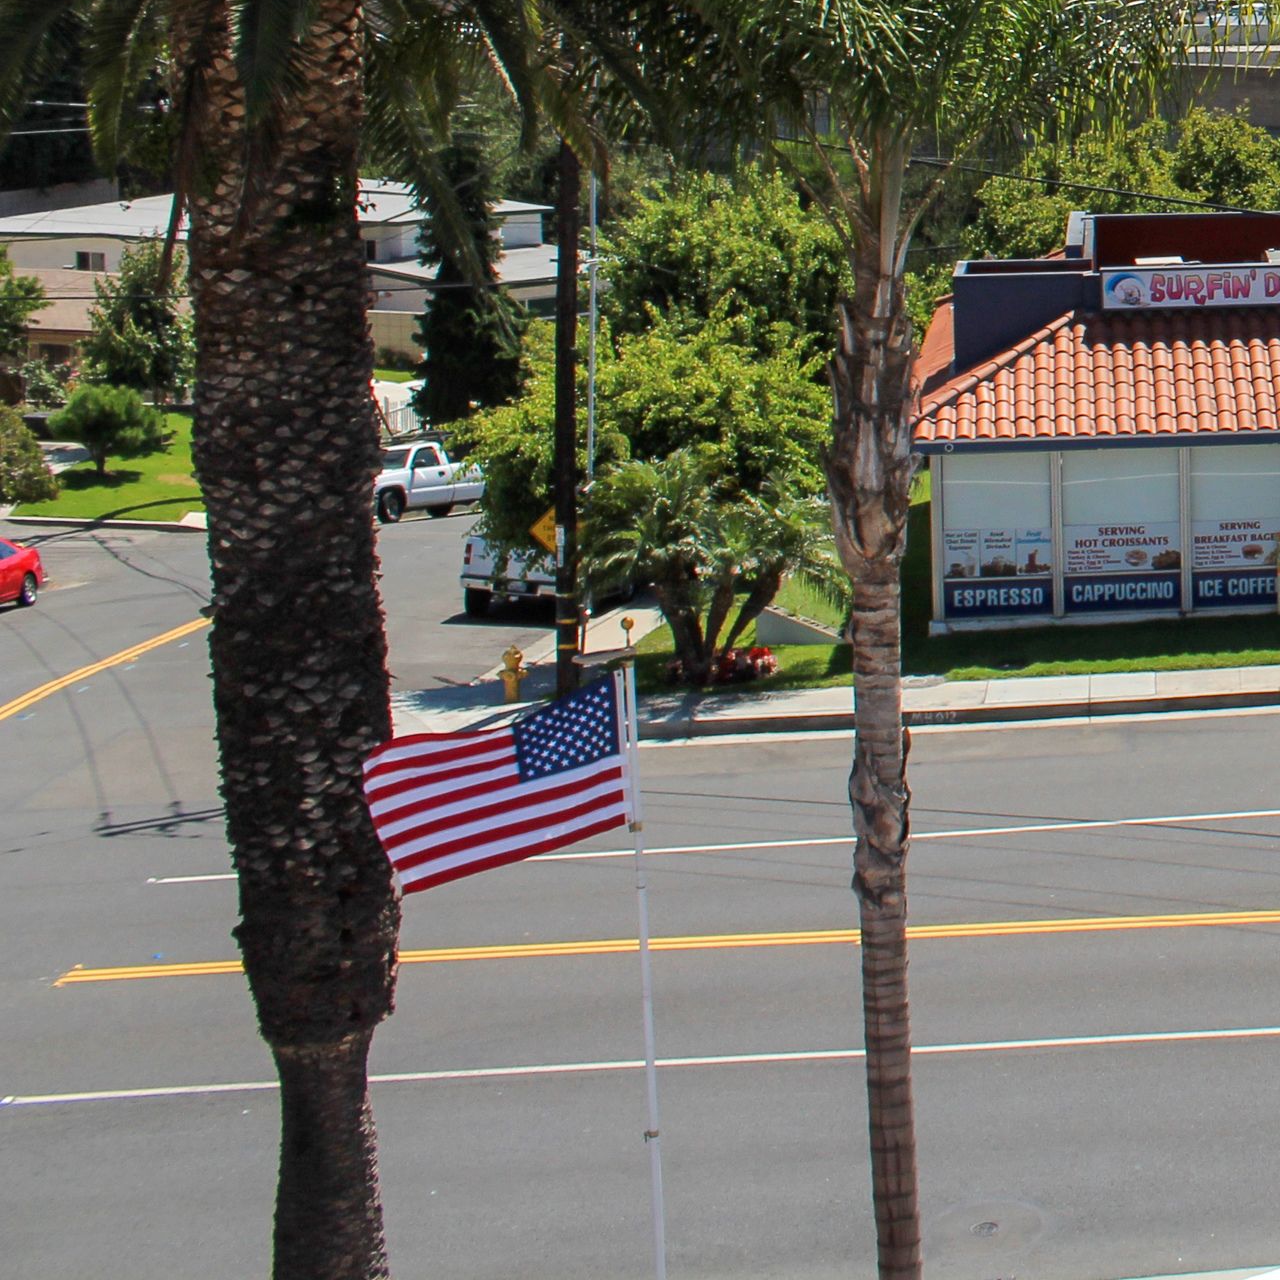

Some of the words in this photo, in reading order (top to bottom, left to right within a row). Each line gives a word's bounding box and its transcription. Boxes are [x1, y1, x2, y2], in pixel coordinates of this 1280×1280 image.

[1098, 526, 1145, 536] SERVING
[1219, 521, 1261, 530] SERVING
[1075, 539, 1098, 548] HOT
[1102, 536, 1169, 548] CROISSANTS
[1194, 534, 1248, 544] BREAKFAST
[1072, 581, 1174, 602] CAPPUCCINO
[1199, 579, 1222, 597] ICE
[953, 587, 1043, 607] ESPRESSO
